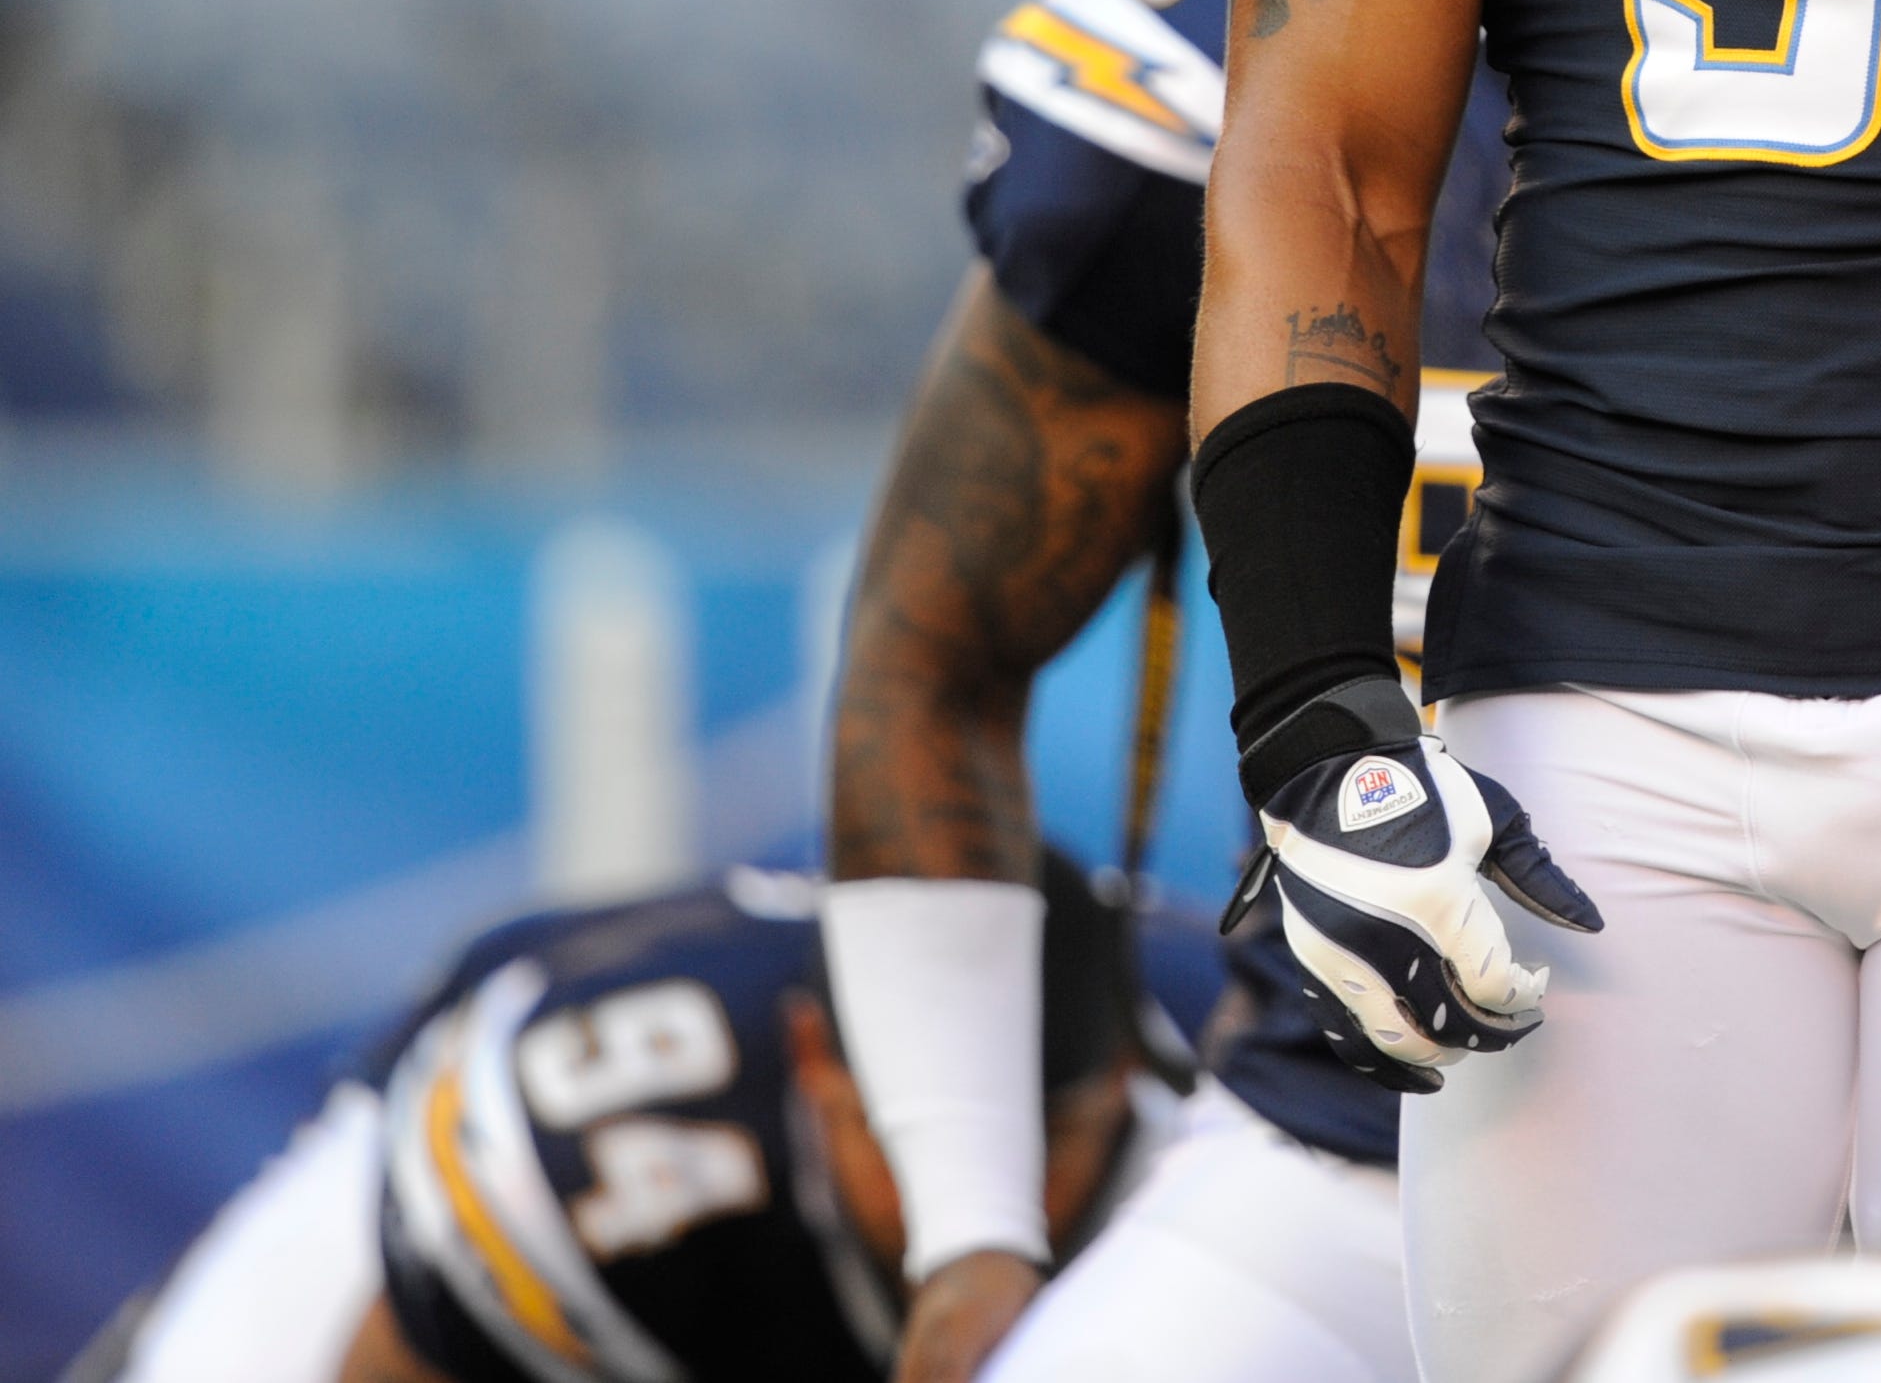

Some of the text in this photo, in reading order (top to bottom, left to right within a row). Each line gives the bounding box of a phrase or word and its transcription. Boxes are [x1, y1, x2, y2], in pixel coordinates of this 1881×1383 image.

[1357, 770, 1390, 792] NFL
[1351, 791, 1414, 822] EQUIPMENT
[516, 975, 772, 1265] 94
